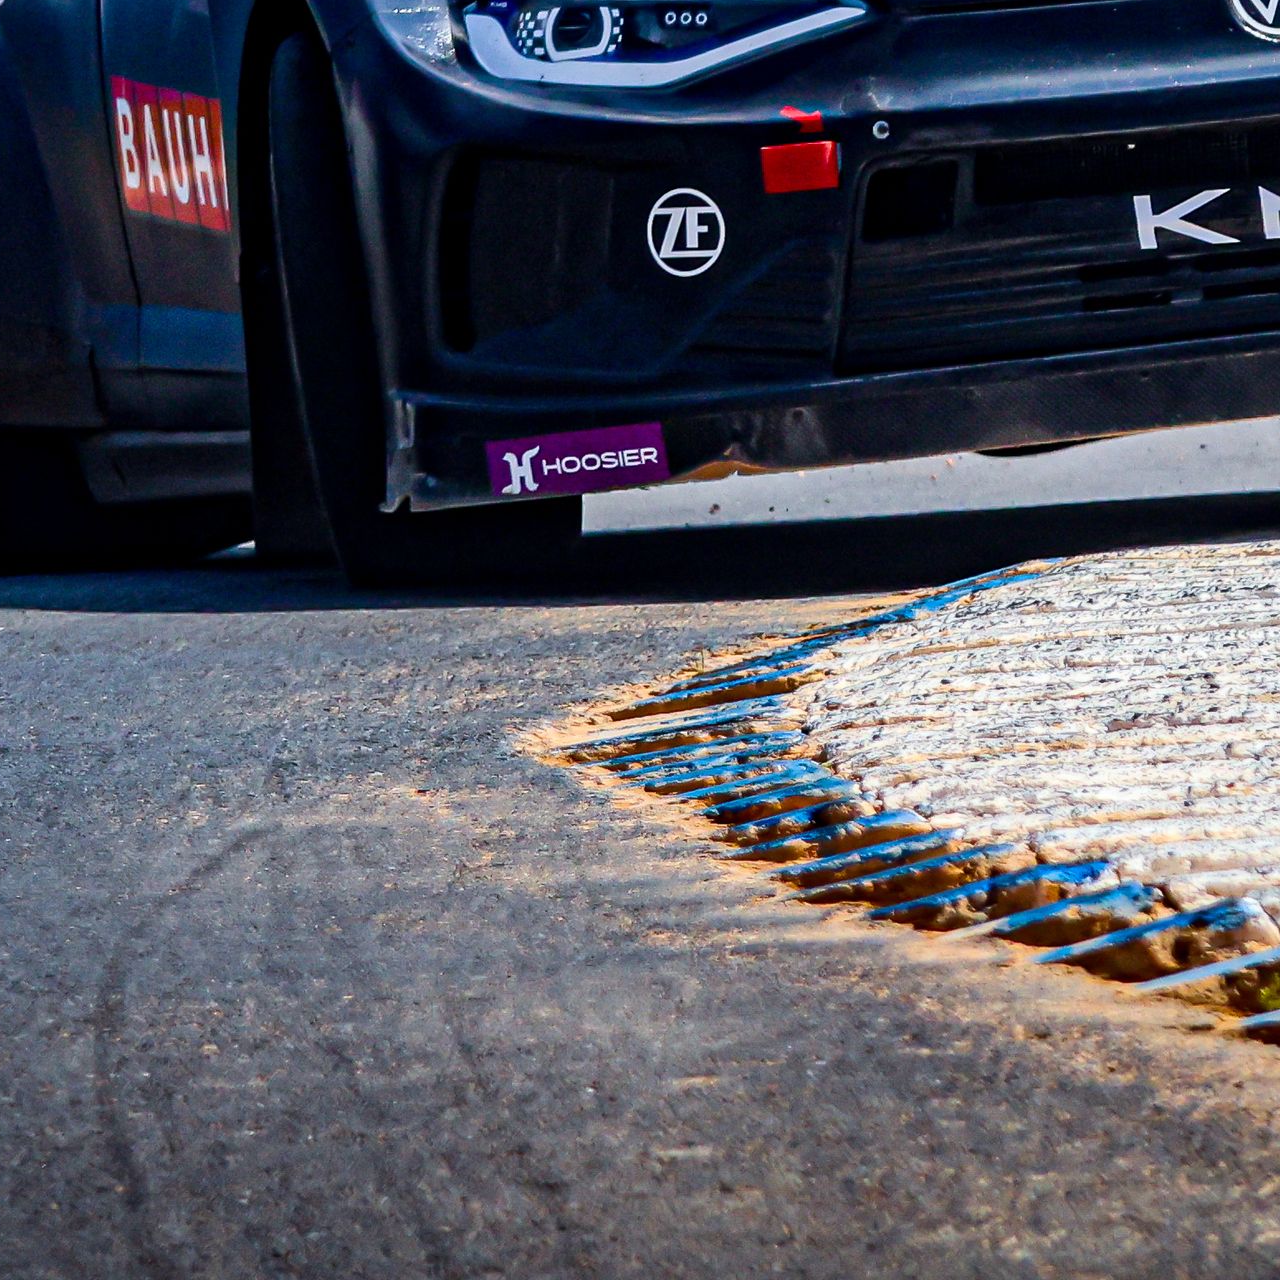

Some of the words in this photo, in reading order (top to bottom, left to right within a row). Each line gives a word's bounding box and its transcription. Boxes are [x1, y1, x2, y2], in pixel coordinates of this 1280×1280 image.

[115, 96, 230, 212] BAUH
[650, 204, 723, 261] ZF
[541, 447, 659, 476] HOOSIER
